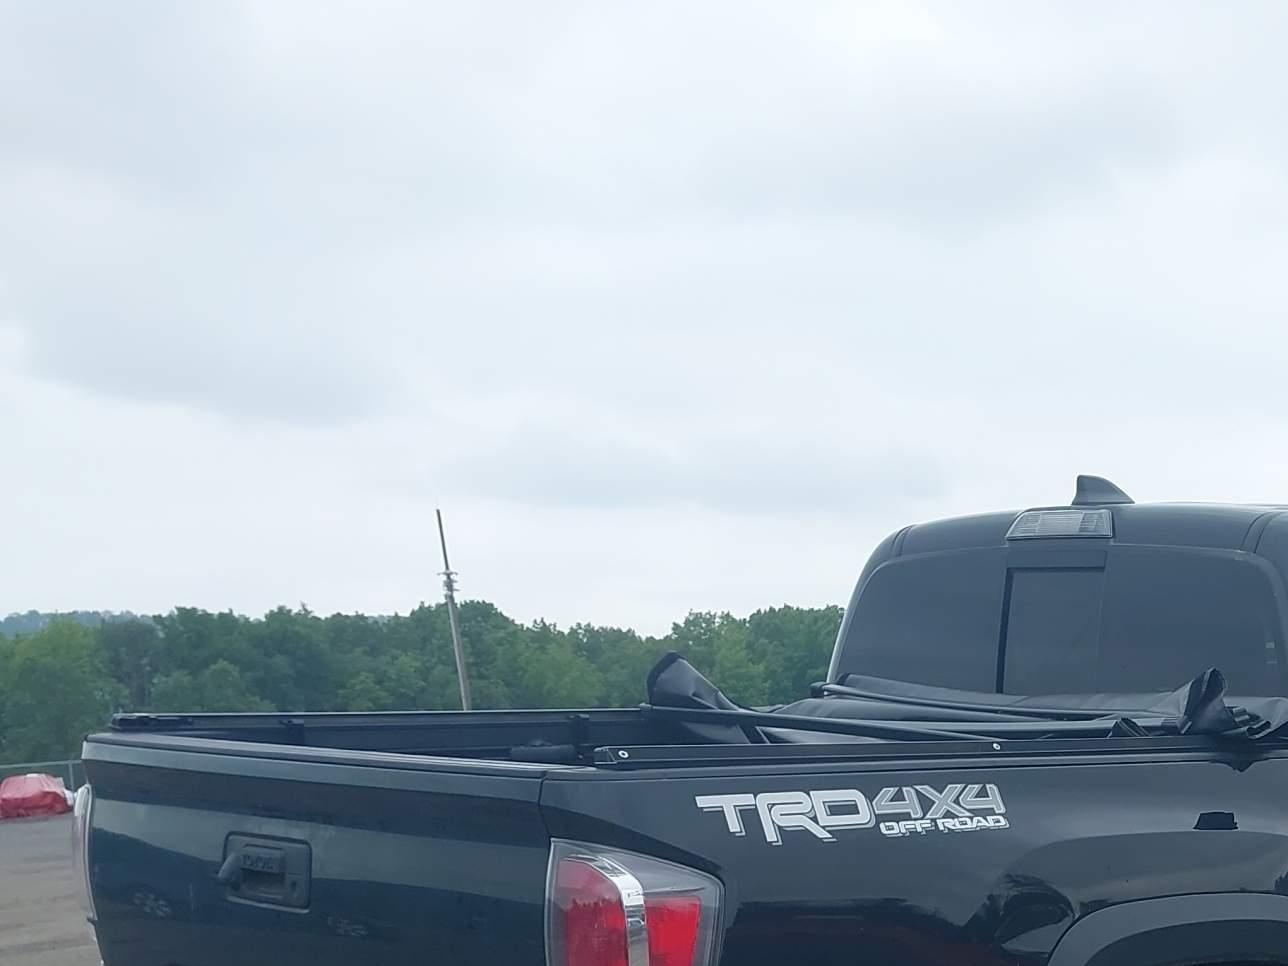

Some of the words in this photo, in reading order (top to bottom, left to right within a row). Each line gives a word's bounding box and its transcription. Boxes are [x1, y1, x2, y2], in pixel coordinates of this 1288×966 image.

[695, 788, 877, 846] TRD
[879, 820, 935, 837] OFF
[936, 815, 1010, 833] ROAD
